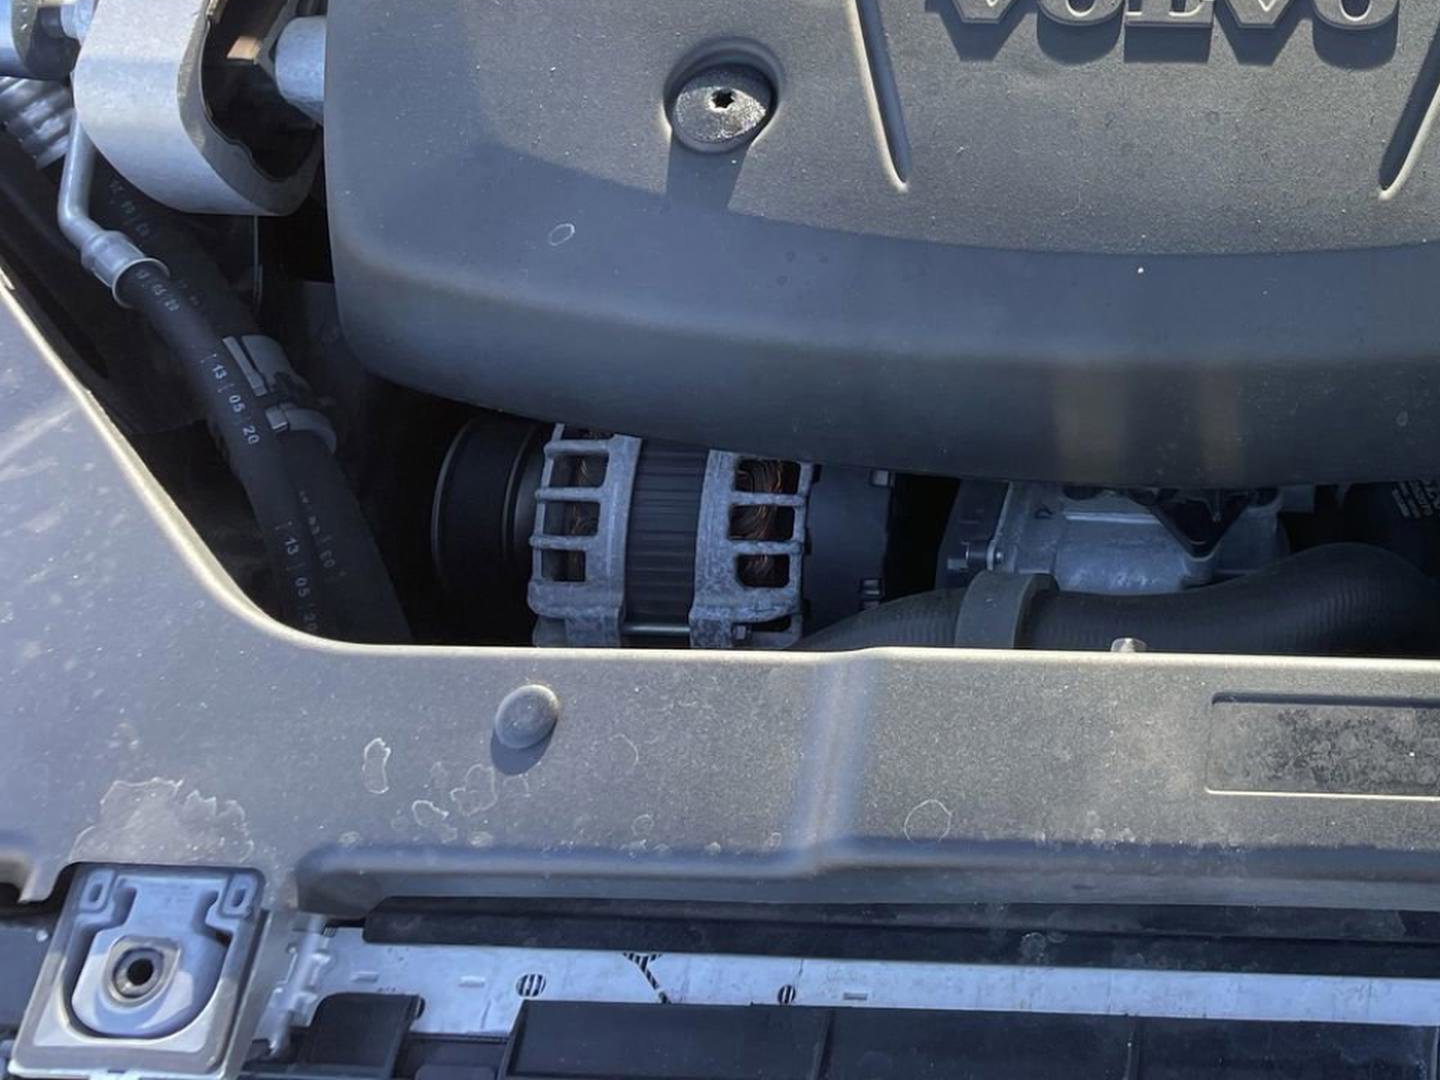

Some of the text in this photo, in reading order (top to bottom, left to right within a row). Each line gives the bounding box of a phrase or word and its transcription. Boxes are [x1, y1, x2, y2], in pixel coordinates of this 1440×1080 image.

[212, 364, 260, 445] 13 05 20
